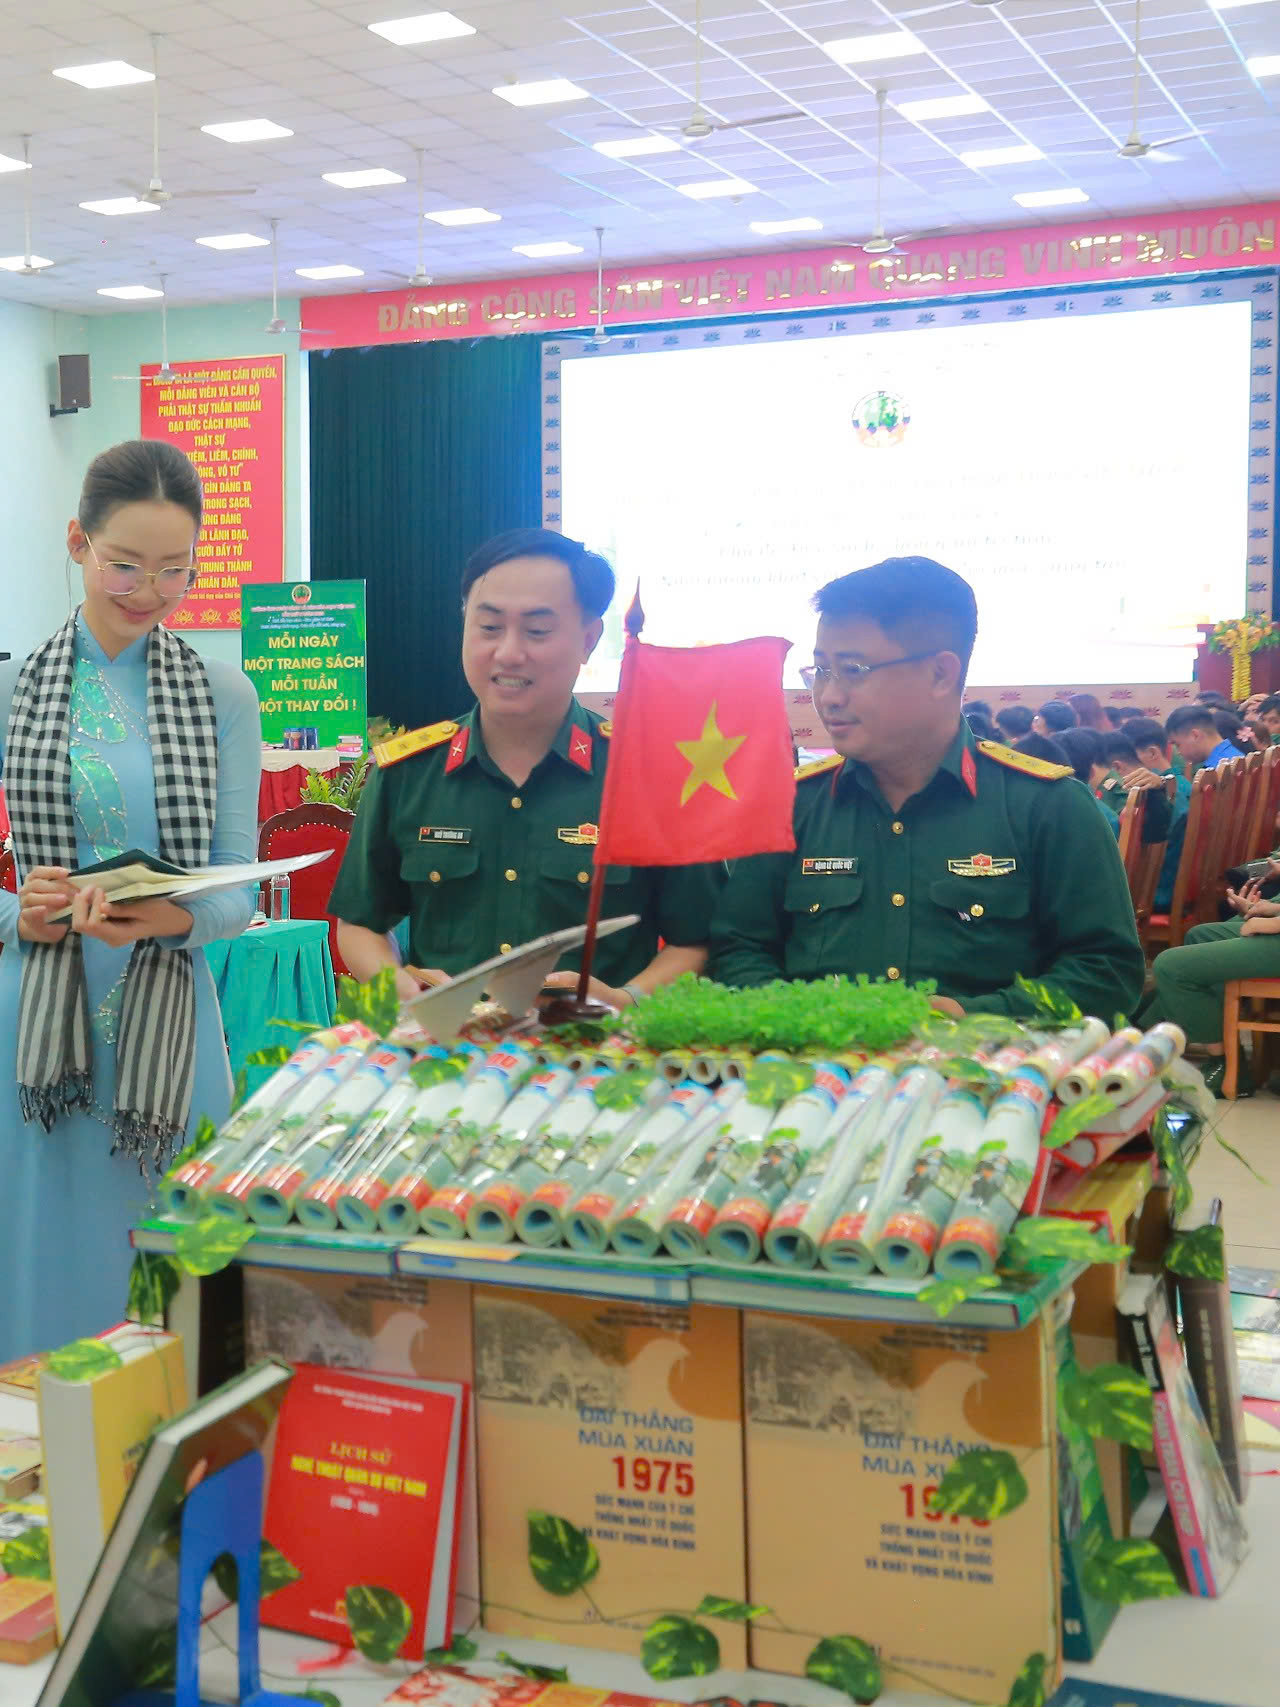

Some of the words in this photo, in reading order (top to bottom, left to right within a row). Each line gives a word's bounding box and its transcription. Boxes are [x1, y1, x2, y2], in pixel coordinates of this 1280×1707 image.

[377, 293, 470, 333] ĐẢNG
[482, 286, 575, 329] CỘNG
[674, 267, 754, 311] VIỆT
[765, 262, 857, 300] NAM
[868, 246, 1006, 291] QUANG
[1020, 233, 1123, 275] VINH
[219, 383, 229, 397] VÀ
[203, 417, 224, 431] CÁCH
[243, 480, 252, 492] TA
[195, 544, 214, 557] GƯỜI
[200, 561, 225, 573] TRUNG
[227, 559, 253, 572] THÀNH
[198, 575, 220, 589] NHÂN
[268, 632, 296, 649] MỖI
[299, 632, 339, 648] NGÀY
[244, 656, 274, 673] MỘT
[277, 657, 323, 670] TRANG
[326, 653, 364, 669] SÁCH
[271, 674, 298, 691] MỖI
[302, 672, 338, 690] TUẦN
[286, 699, 320, 713] THAY
[323, 692, 349, 712] ĐỔI
[612, 1455, 695, 1497] 1975
[899, 1483, 992, 1527] 19
